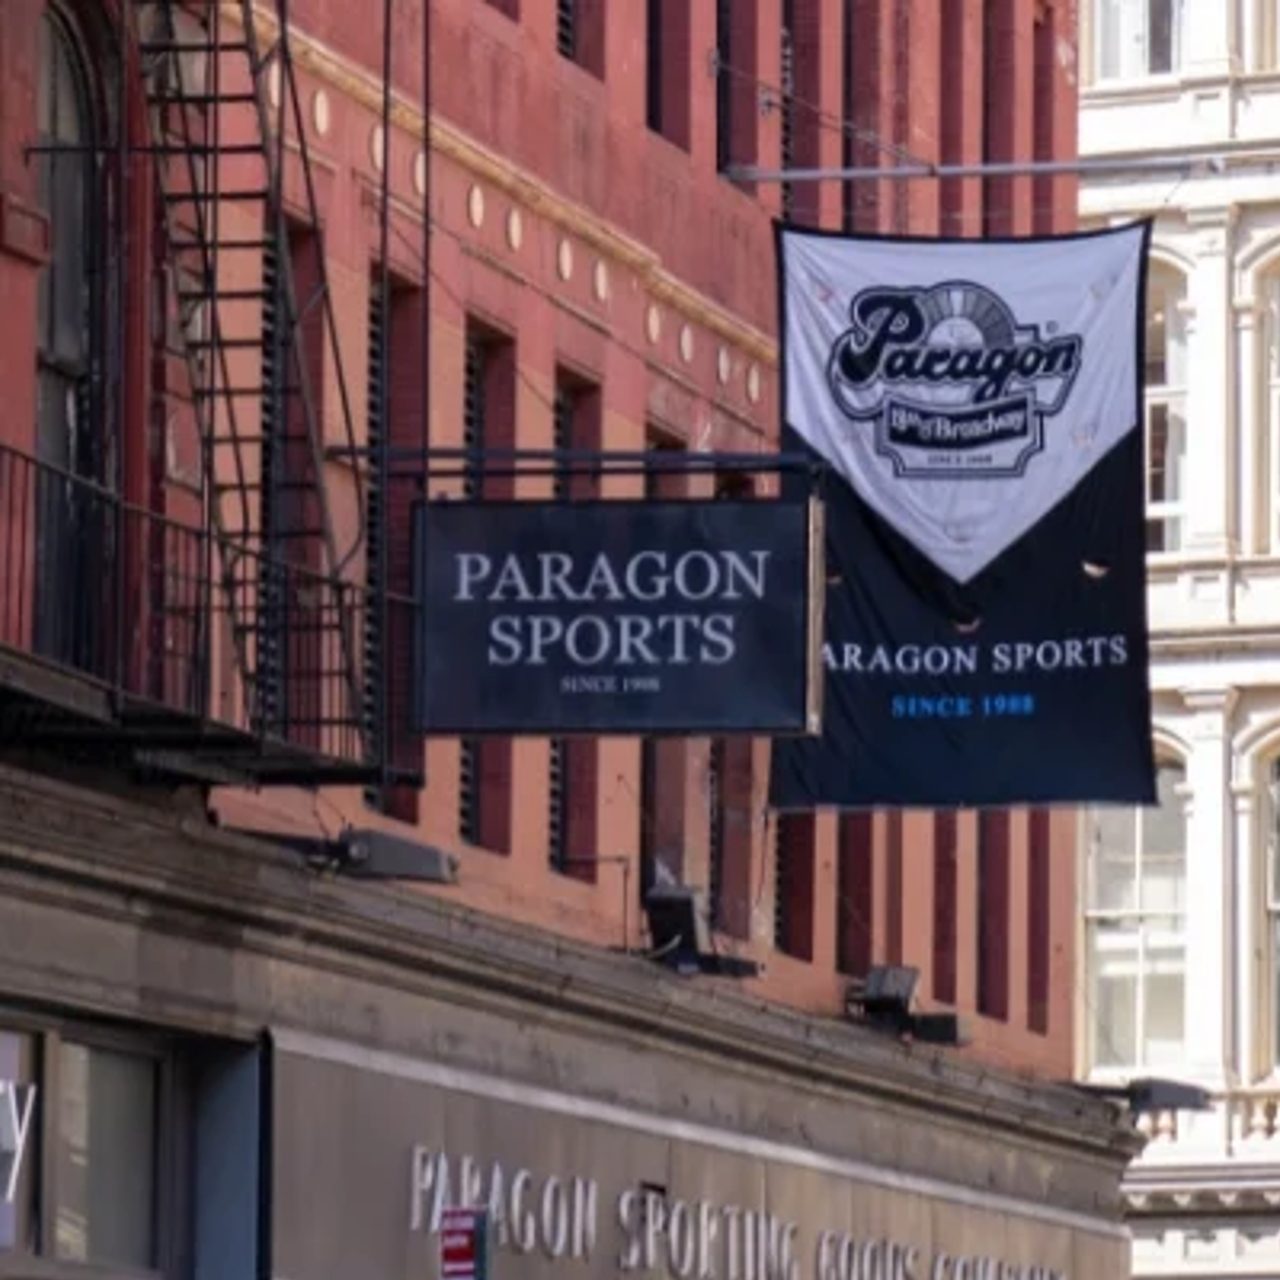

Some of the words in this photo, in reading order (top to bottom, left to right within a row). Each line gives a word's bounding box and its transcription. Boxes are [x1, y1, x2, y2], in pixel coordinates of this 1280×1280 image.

[838, 295, 1077, 404] Paragon
[454, 550, 770, 601] PARAGON
[488, 613, 736, 666] SPORTS
[822, 642, 978, 674] ARAGON
[992, 634, 1128, 673] SPORTS
[561, 676, 616, 693] SINCE
[891, 695, 973, 717] SINCE
[410, 1145, 598, 1258] PARAGON
